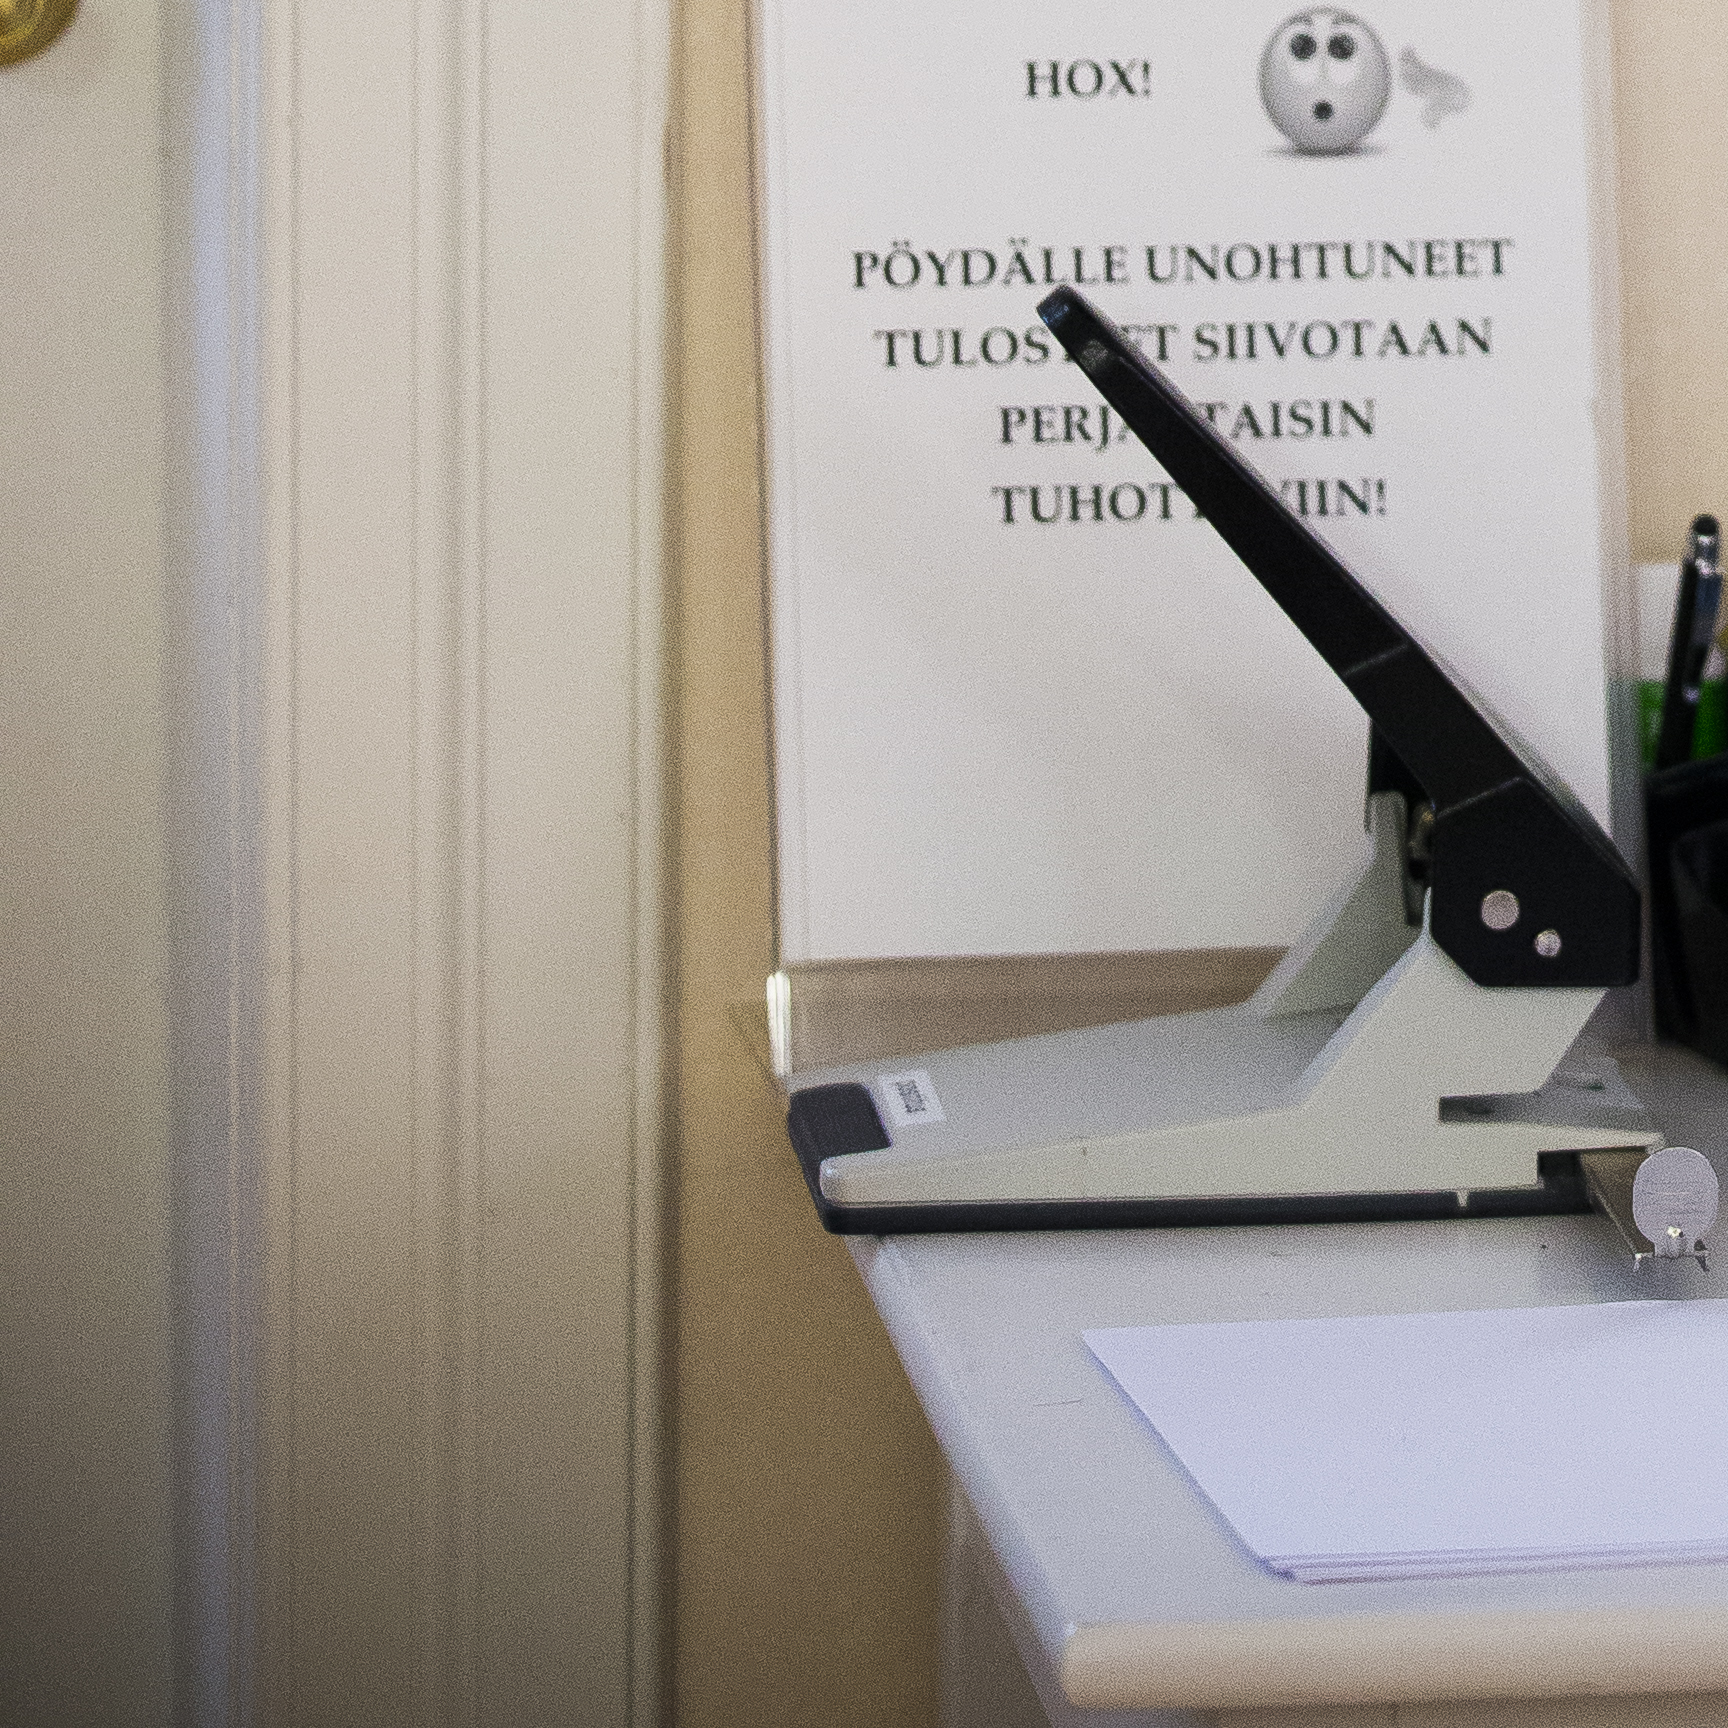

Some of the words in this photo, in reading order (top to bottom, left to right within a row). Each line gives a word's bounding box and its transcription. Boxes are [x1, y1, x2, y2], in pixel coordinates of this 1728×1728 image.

[1024, 57, 1153, 99] HOX!
[853, 238, 1130, 289] PÖYDÄLLE
[1146, 237, 1513, 283] UNOHTUNEET
[1193, 317, 1494, 362] SIIVOTAAN
